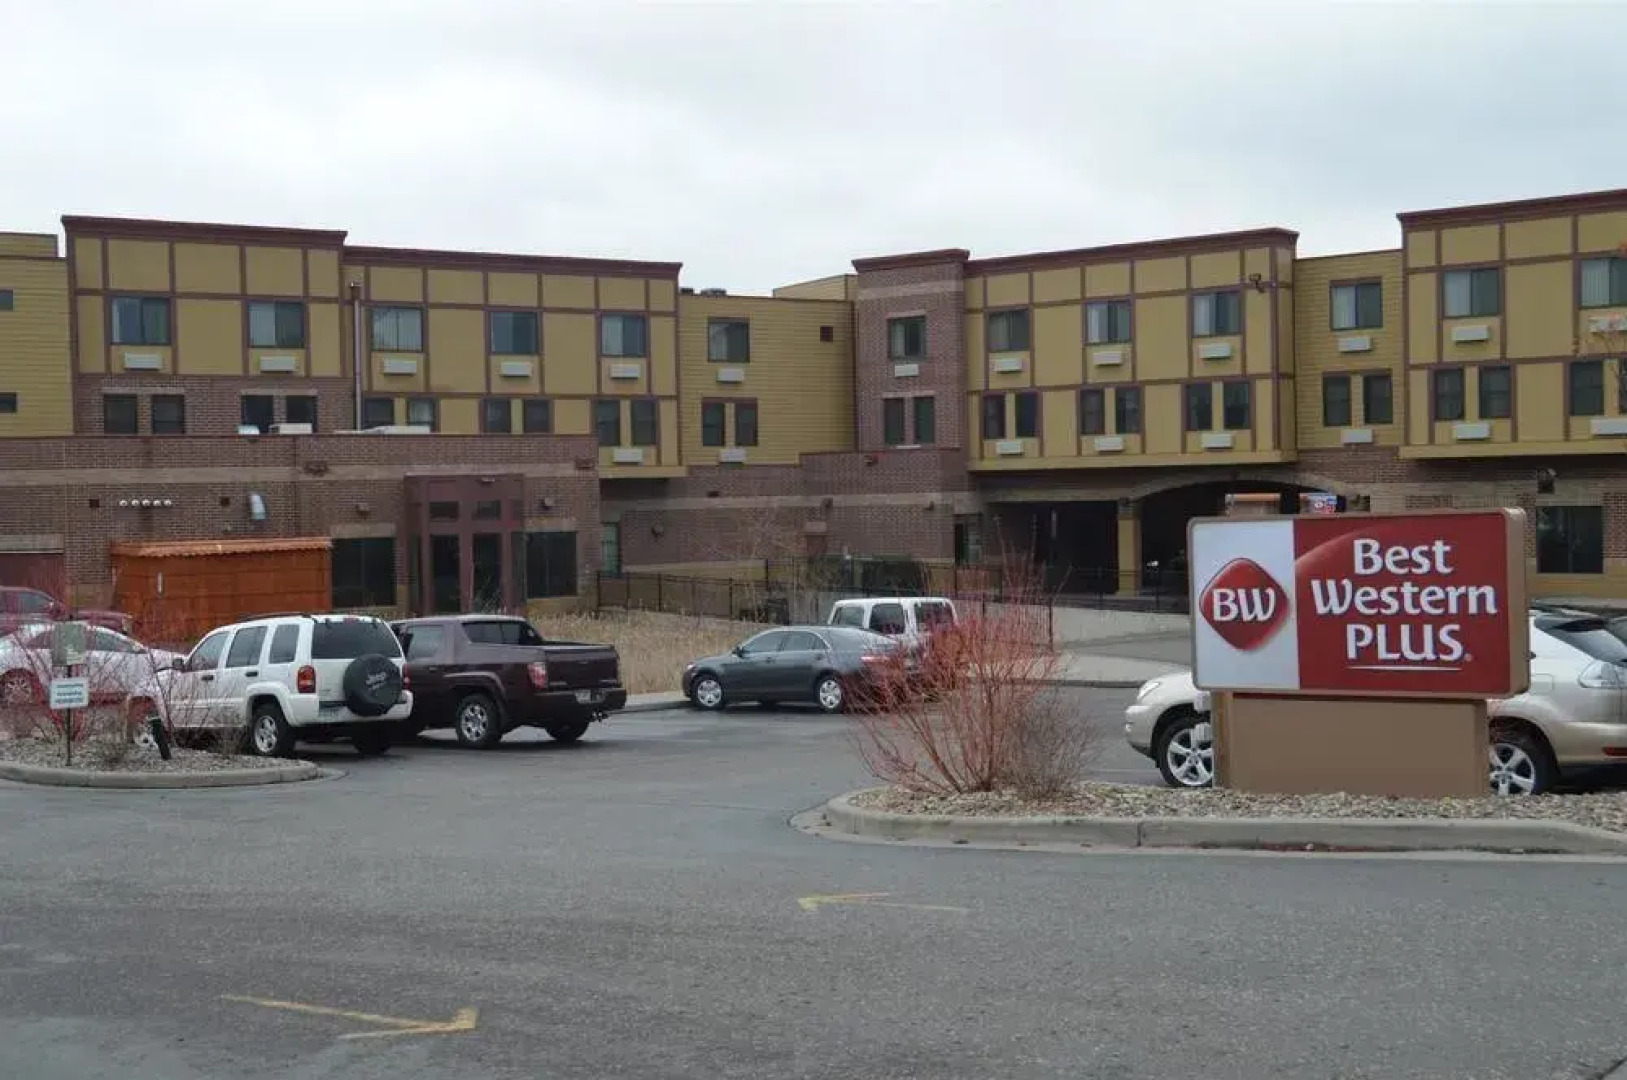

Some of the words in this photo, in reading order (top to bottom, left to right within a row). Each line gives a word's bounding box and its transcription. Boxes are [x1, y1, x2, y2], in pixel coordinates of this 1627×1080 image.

[1353, 538, 1454, 575] Best
[1211, 587, 1277, 622] BW
[1311, 578, 1498, 615] Western
[1347, 624, 1464, 661] PLUS
